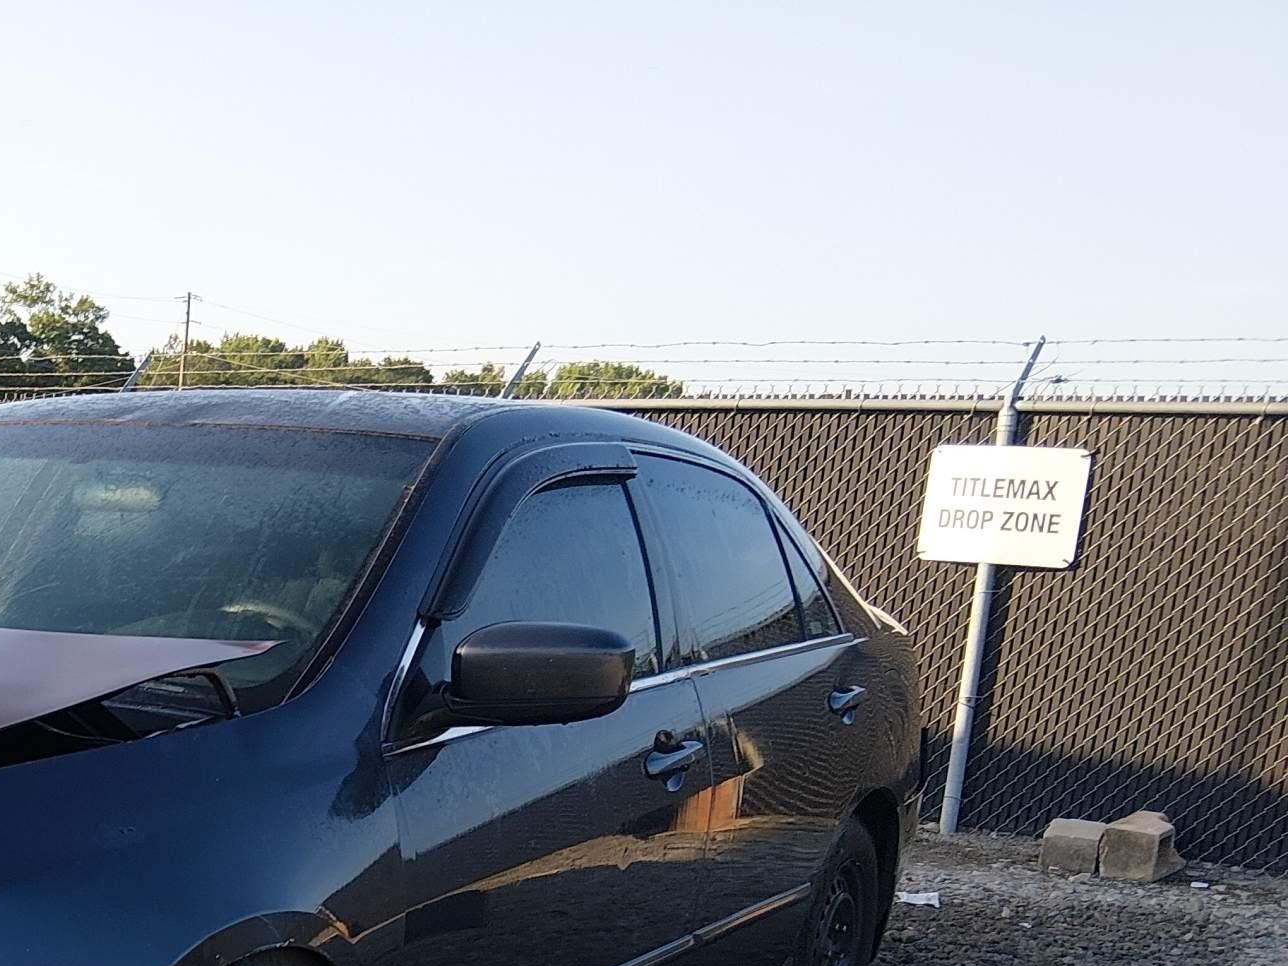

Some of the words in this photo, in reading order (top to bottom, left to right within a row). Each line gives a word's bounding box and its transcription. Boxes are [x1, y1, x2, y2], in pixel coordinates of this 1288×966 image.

[951, 477, 1060, 501] TITLEMAX
[938, 508, 994, 530] DROP
[999, 511, 1062, 534] ZONE
